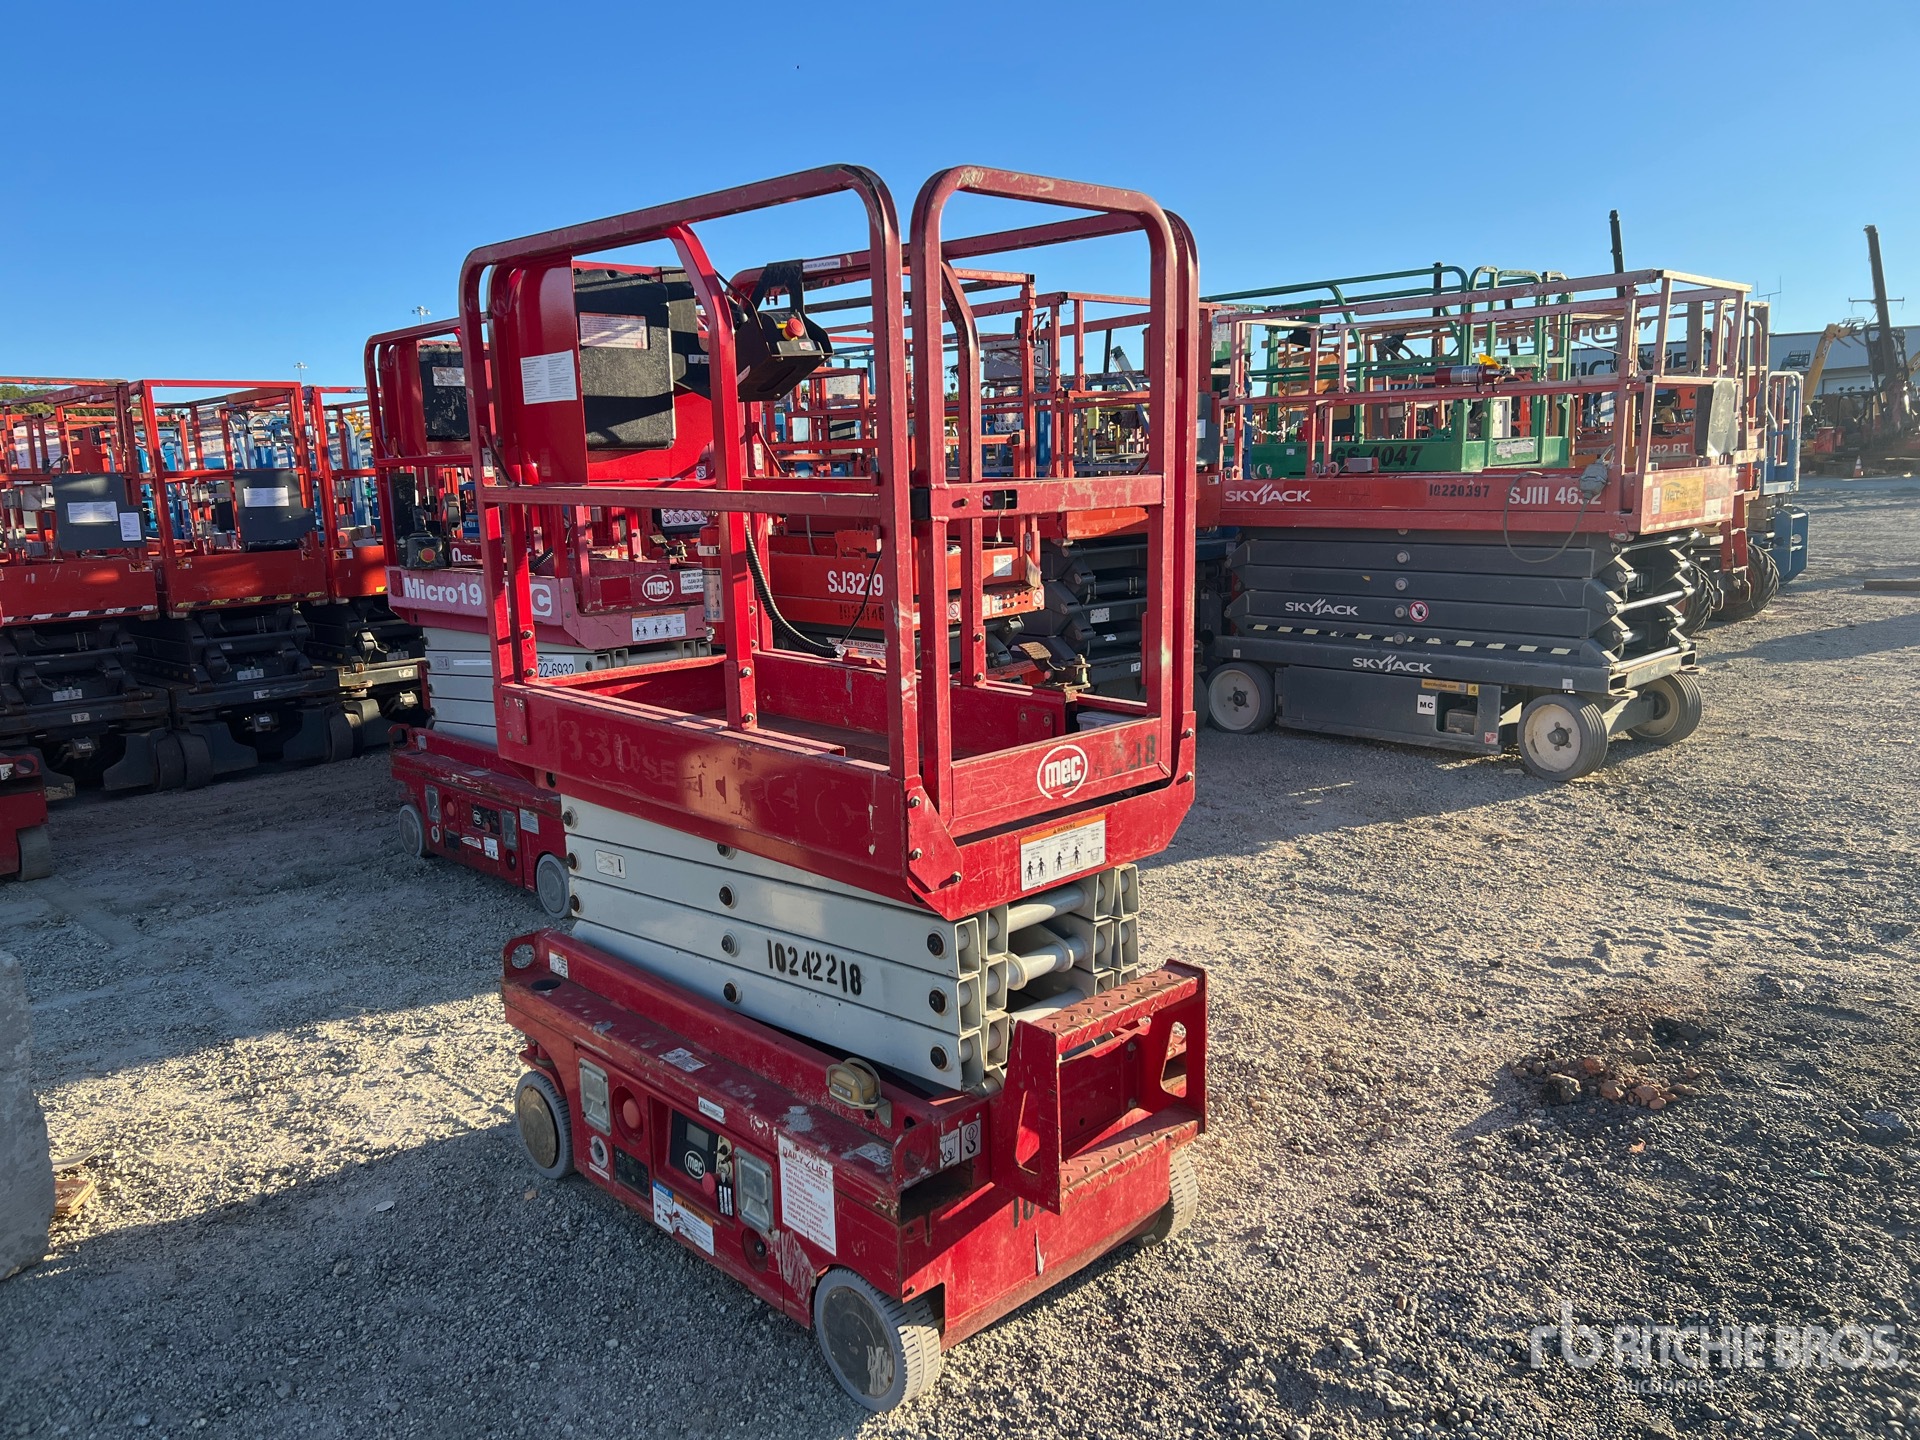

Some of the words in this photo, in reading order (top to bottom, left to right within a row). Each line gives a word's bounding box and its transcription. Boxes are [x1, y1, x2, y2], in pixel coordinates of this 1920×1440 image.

[1225, 483, 1312, 505] SKYJACK
[403, 577, 483, 606] Micro19
[1284, 598, 1359, 616] SKYJACK
[1352, 654, 1433, 674] SKYJACK
[767, 939, 862, 996] 10242218
